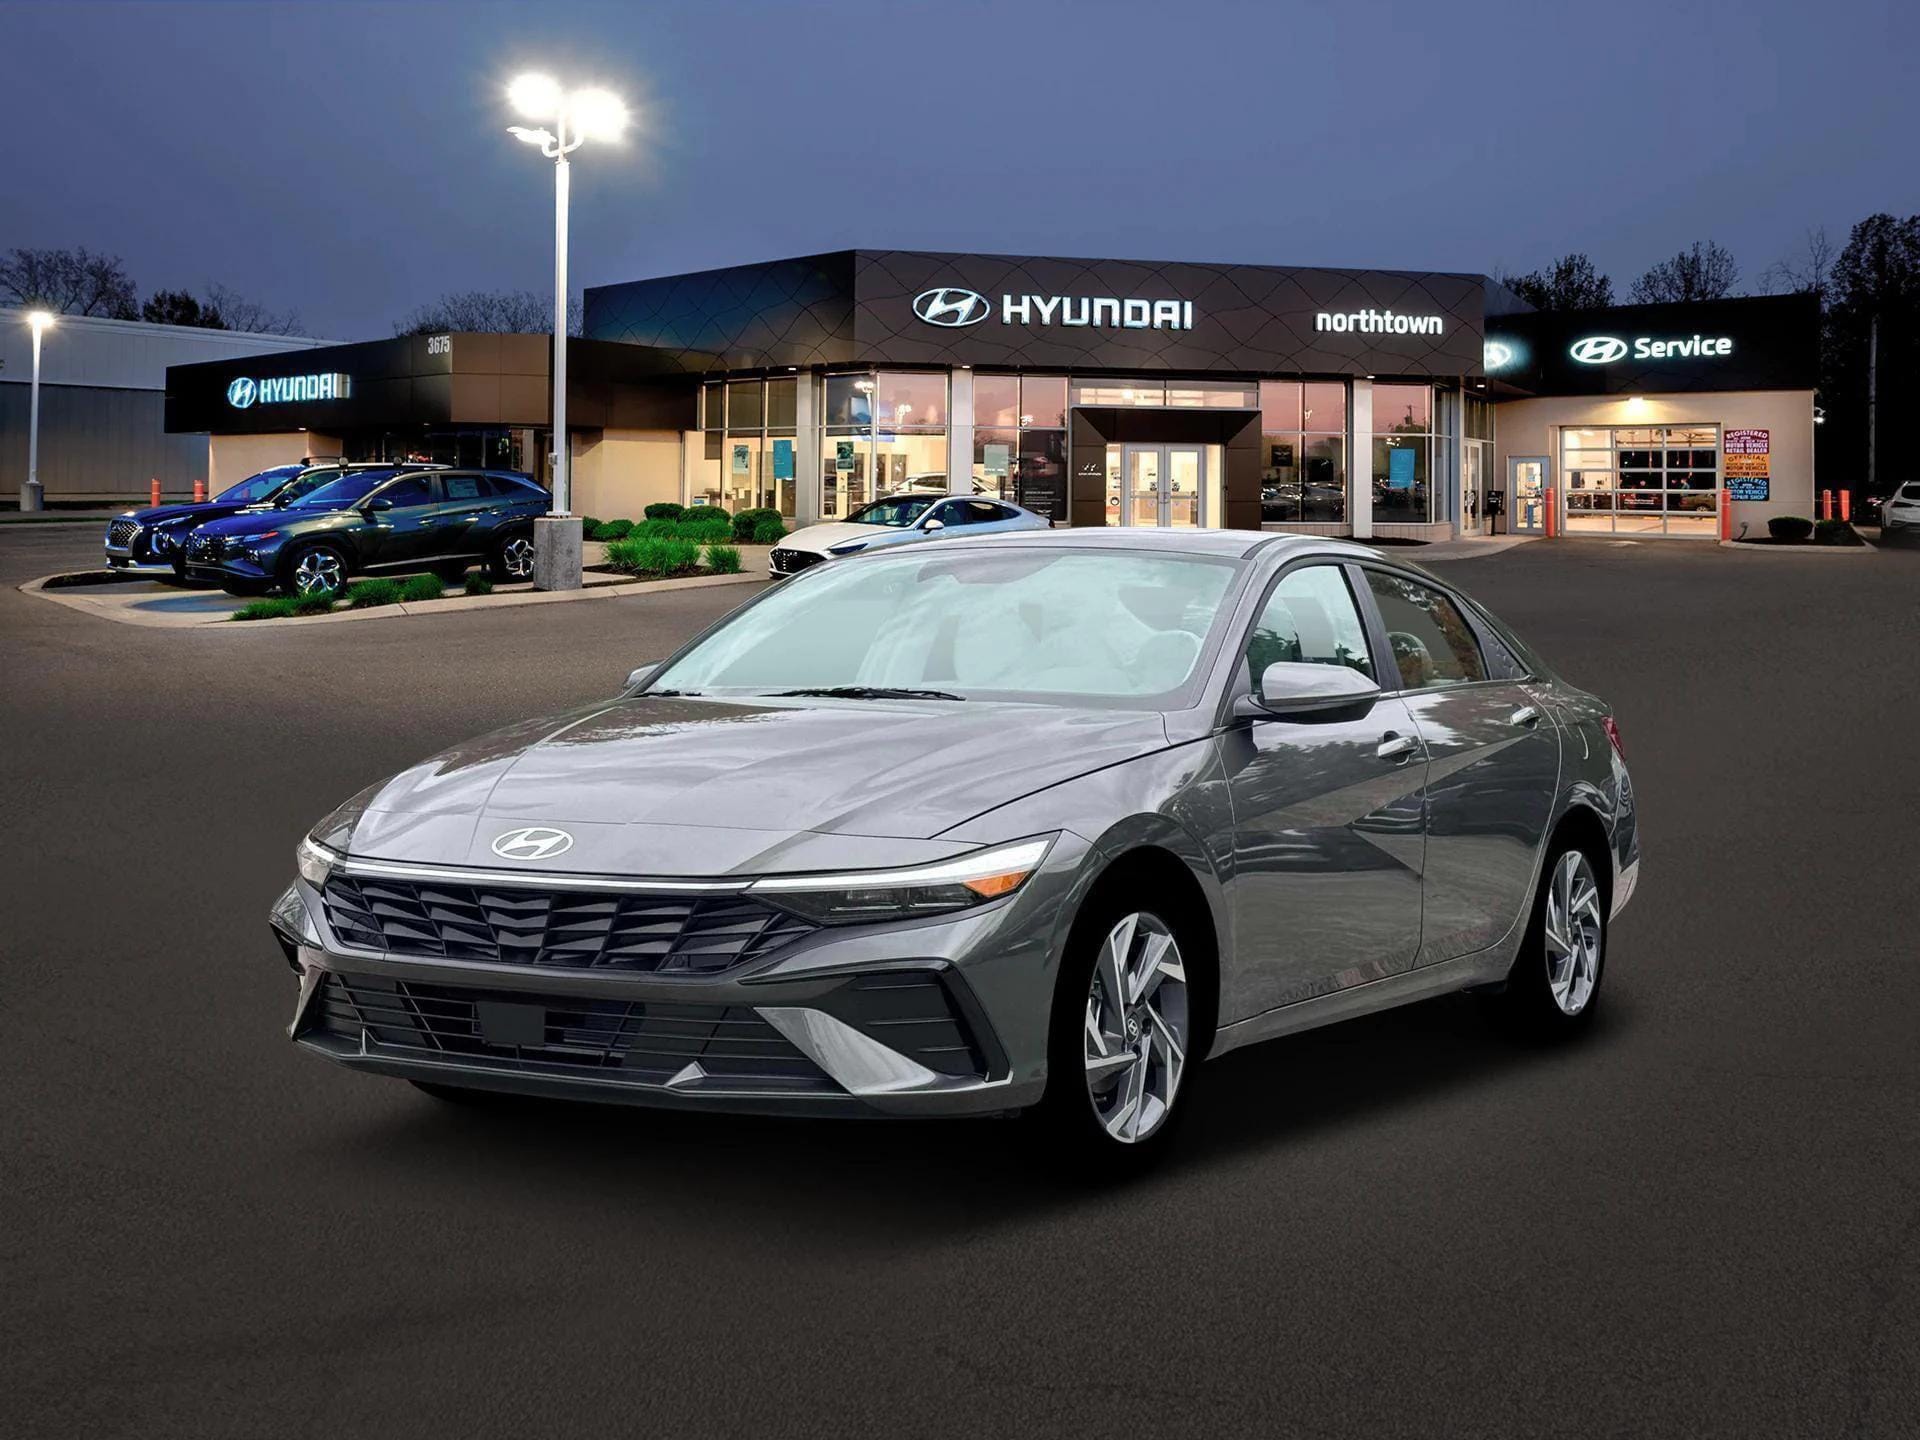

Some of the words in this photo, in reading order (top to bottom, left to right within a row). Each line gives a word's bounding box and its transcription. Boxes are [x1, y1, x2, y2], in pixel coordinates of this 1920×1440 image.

[1002, 294, 1193, 330] HYUNDAI
[1316, 309, 1443, 335] northtown
[427, 335, 451, 355] 3675
[1633, 335, 1732, 359] Service
[259, 372, 338, 404] HYUNDAI
[1726, 431, 1768, 439] REGISTERED
[1728, 454, 1766, 462] OFFICIAL
[1726, 477, 1768, 486] REGISTERED
